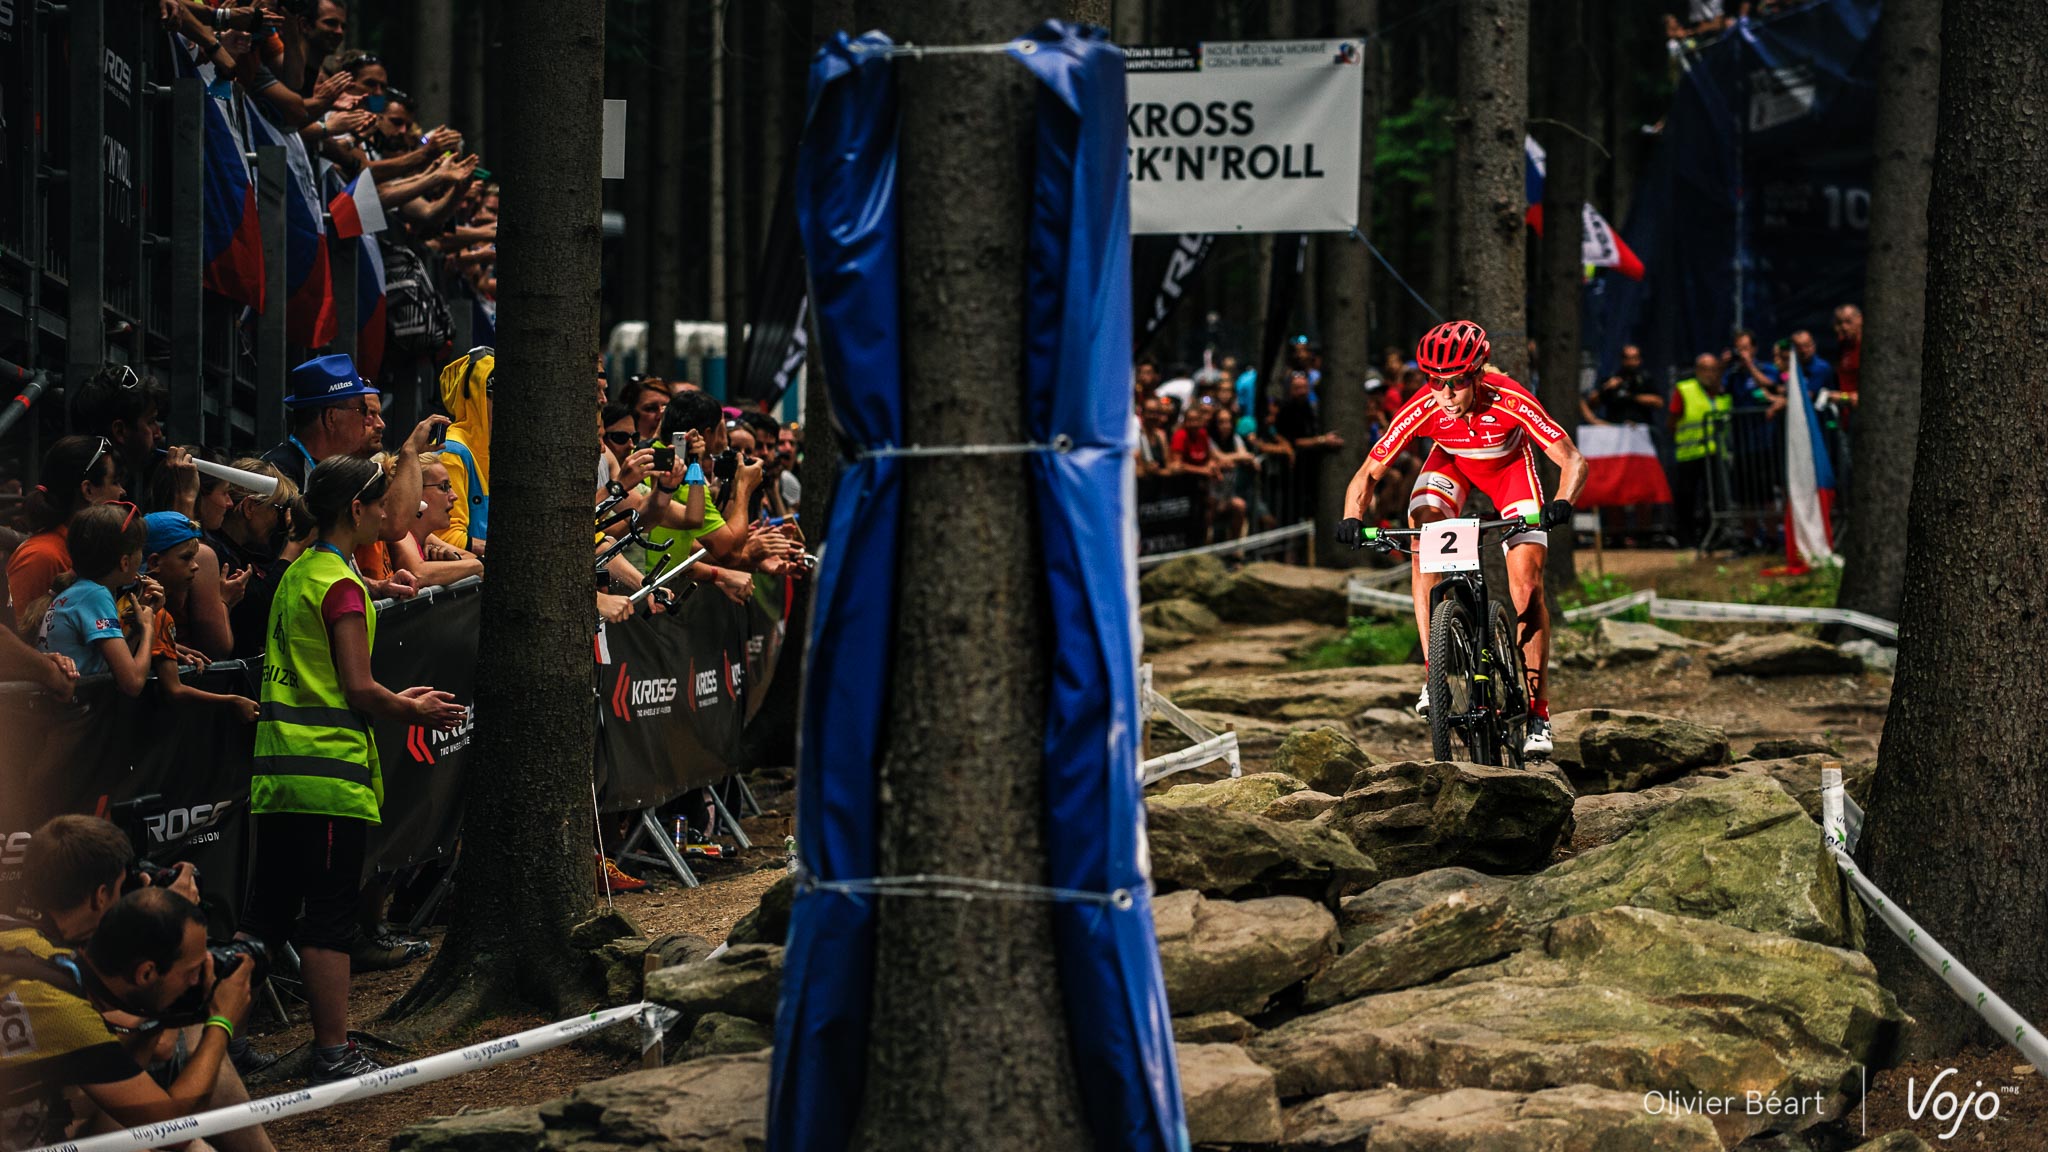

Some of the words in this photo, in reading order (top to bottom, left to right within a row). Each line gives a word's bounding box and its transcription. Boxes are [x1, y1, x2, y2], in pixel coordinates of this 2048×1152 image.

[1129, 144, 1324, 181] K'N'ROLL
[327, 380, 353, 393] Mitas
[1384, 407, 1423, 449] postnord
[1518, 404, 1562, 440] postnord
[1440, 531, 1458, 554] 2
[631, 677, 678, 706] KROSS
[695, 669, 718, 697] KROSS
